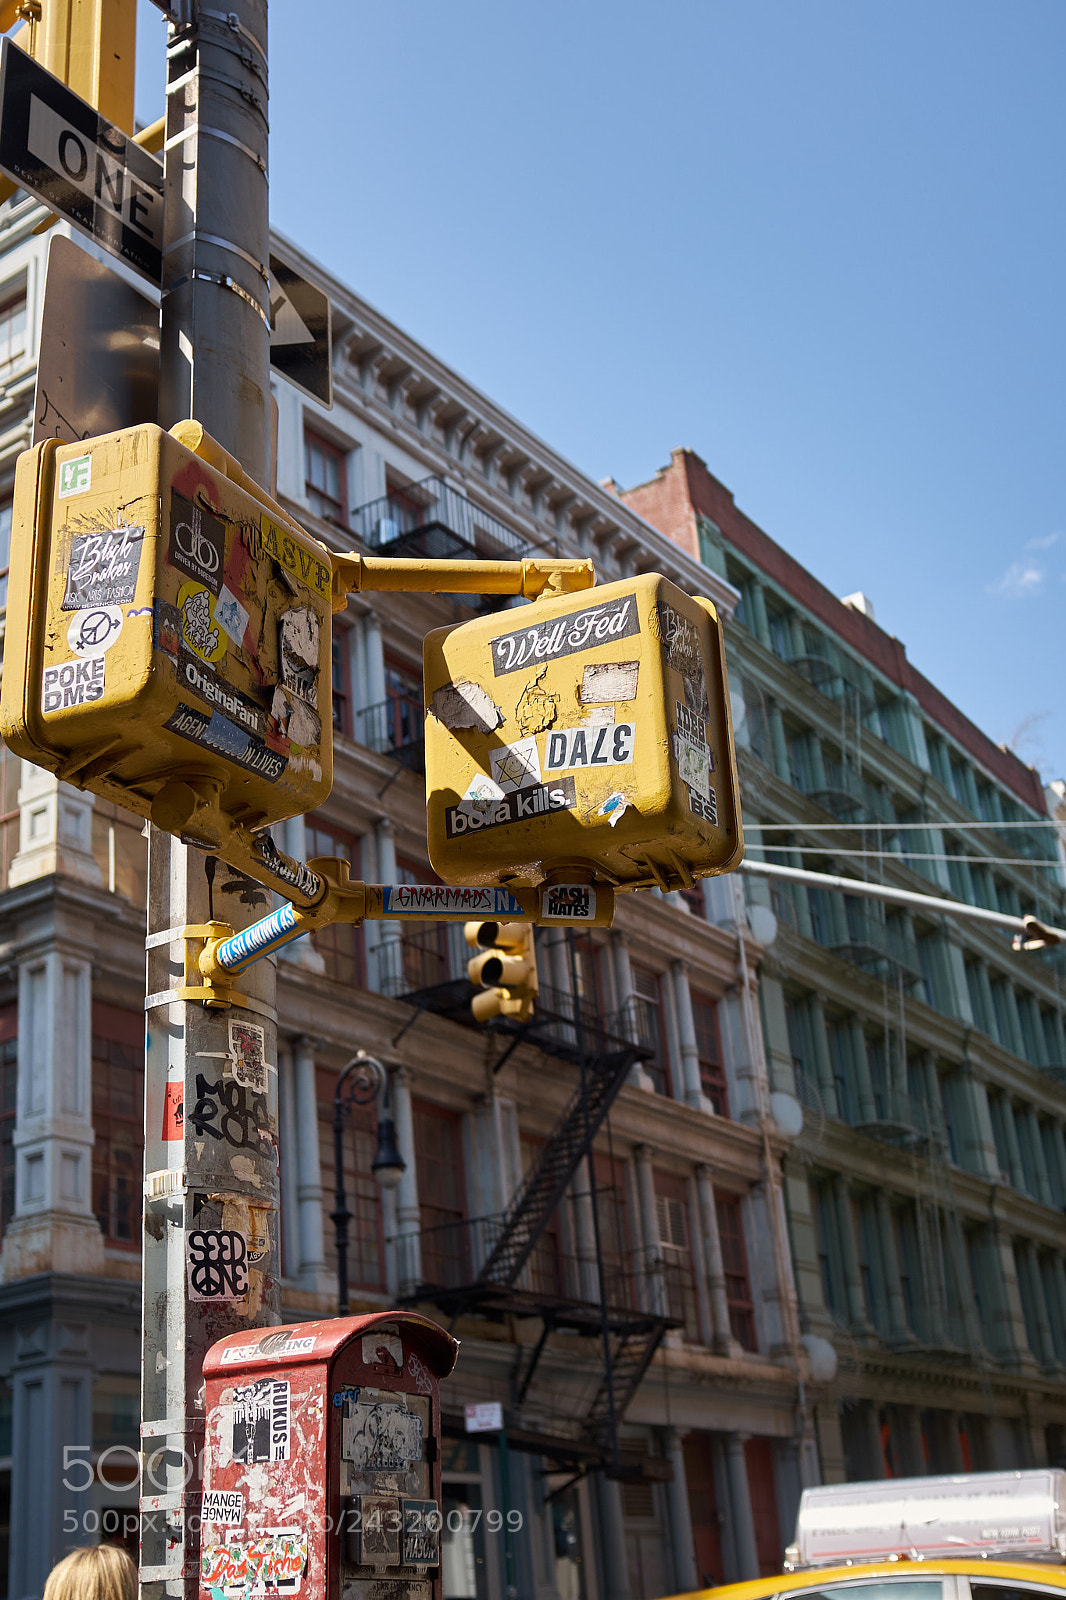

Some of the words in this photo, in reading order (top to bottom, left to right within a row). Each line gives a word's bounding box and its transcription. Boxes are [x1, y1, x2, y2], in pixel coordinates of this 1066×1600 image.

[58, 129, 153, 239] ONE
[14, 164, 39, 187] DEPT
[70, 207, 150, 270] TRANSPORTATION
[265, 524, 330, 592] ASVP
[106, 585, 135, 599] FASHION
[497, 621, 567, 670] Well
[567, 600, 631, 647] Fed
[45, 657, 105, 692] POKE
[44, 680, 104, 712] DMS
[251, 753, 282, 777] LIVES
[516, 786, 571, 818] kills.
[548, 904, 590, 917] HATES
[221, 937, 248, 966] ALSO
[244, 919, 282, 951] KNOWN
[280, 907, 296, 931] AS
[188, 1230, 247, 1266] SEED
[272, 1381, 288, 1445] RUKUS
[203, 1492, 243, 1507] MANGE
